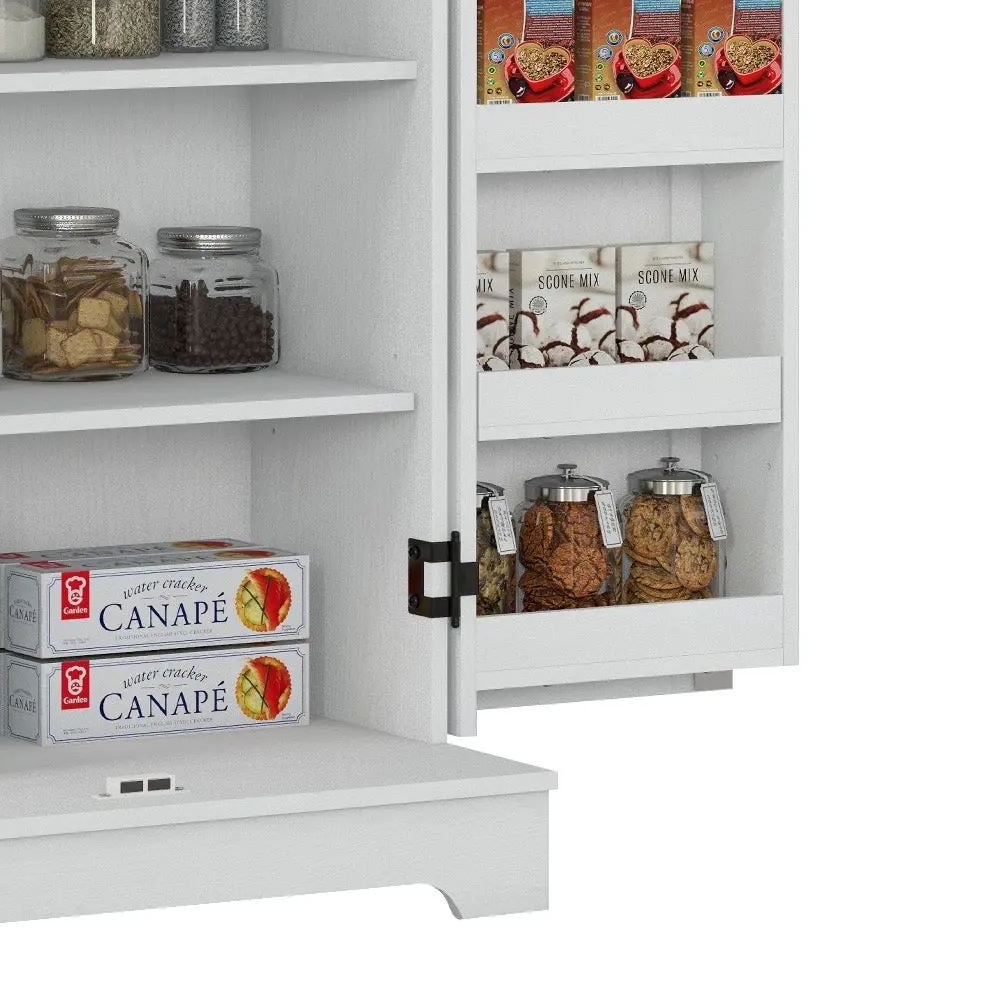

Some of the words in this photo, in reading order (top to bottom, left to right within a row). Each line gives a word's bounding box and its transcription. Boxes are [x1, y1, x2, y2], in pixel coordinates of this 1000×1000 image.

[538, 274, 575, 290] SCONE
[579, 272, 600, 288] MIX
[638, 269, 674, 285] SCONE
[679, 267, 699, 282] MIX
[123, 579, 160, 600] water
[162, 576, 209, 593] cracker
[63, 606, 88, 615] Garden
[99, 592, 229, 632] CANAPÉ
[123, 668, 160, 689] water
[162, 666, 209, 682] cracker
[63, 696, 88, 705] Garden
[99, 681, 229, 721] CANAPÉ
